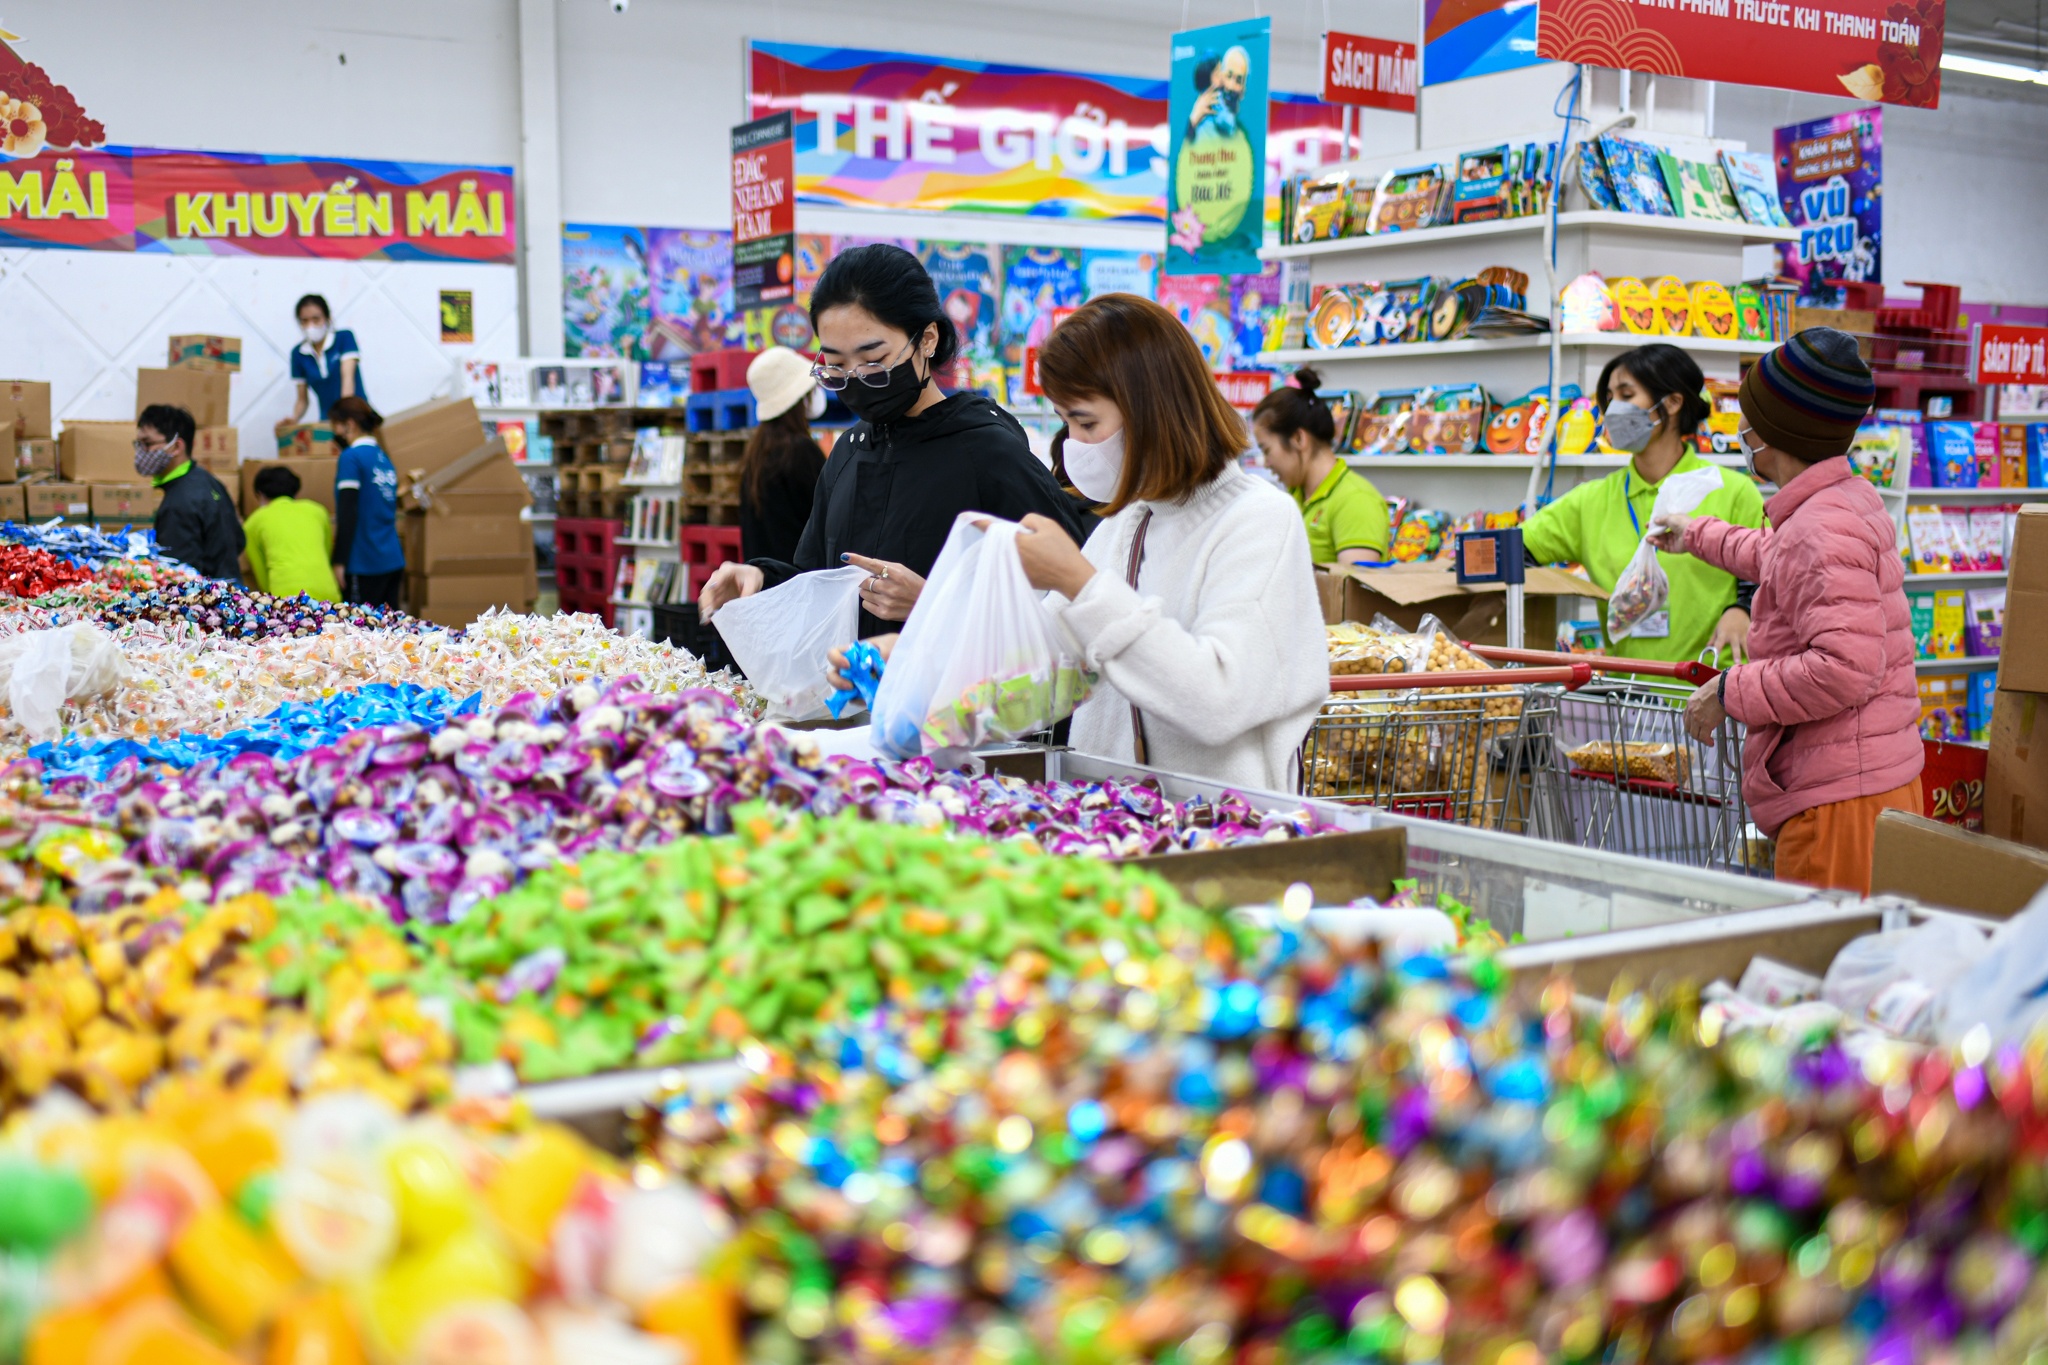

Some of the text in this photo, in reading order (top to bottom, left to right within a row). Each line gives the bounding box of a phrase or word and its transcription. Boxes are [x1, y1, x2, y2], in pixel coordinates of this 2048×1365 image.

[1734, 0, 1790, 27] TRƯỚC
[1794, 6, 1820, 31] KHI
[1825, 11, 1875, 39] THANH
[1880, 17, 1920, 46] TOÁN
[1331, 41, 1374, 90] SÁCH
[800, 81, 957, 165] THẾ
[978, 102, 1127, 177] GIỚI
[0, 159, 108, 219] MÃI
[174, 177, 506, 238] KHUYẾN MÃI
[1982, 335, 2011, 373] SÁCH
[2011, 336, 2031, 380] TẬP
